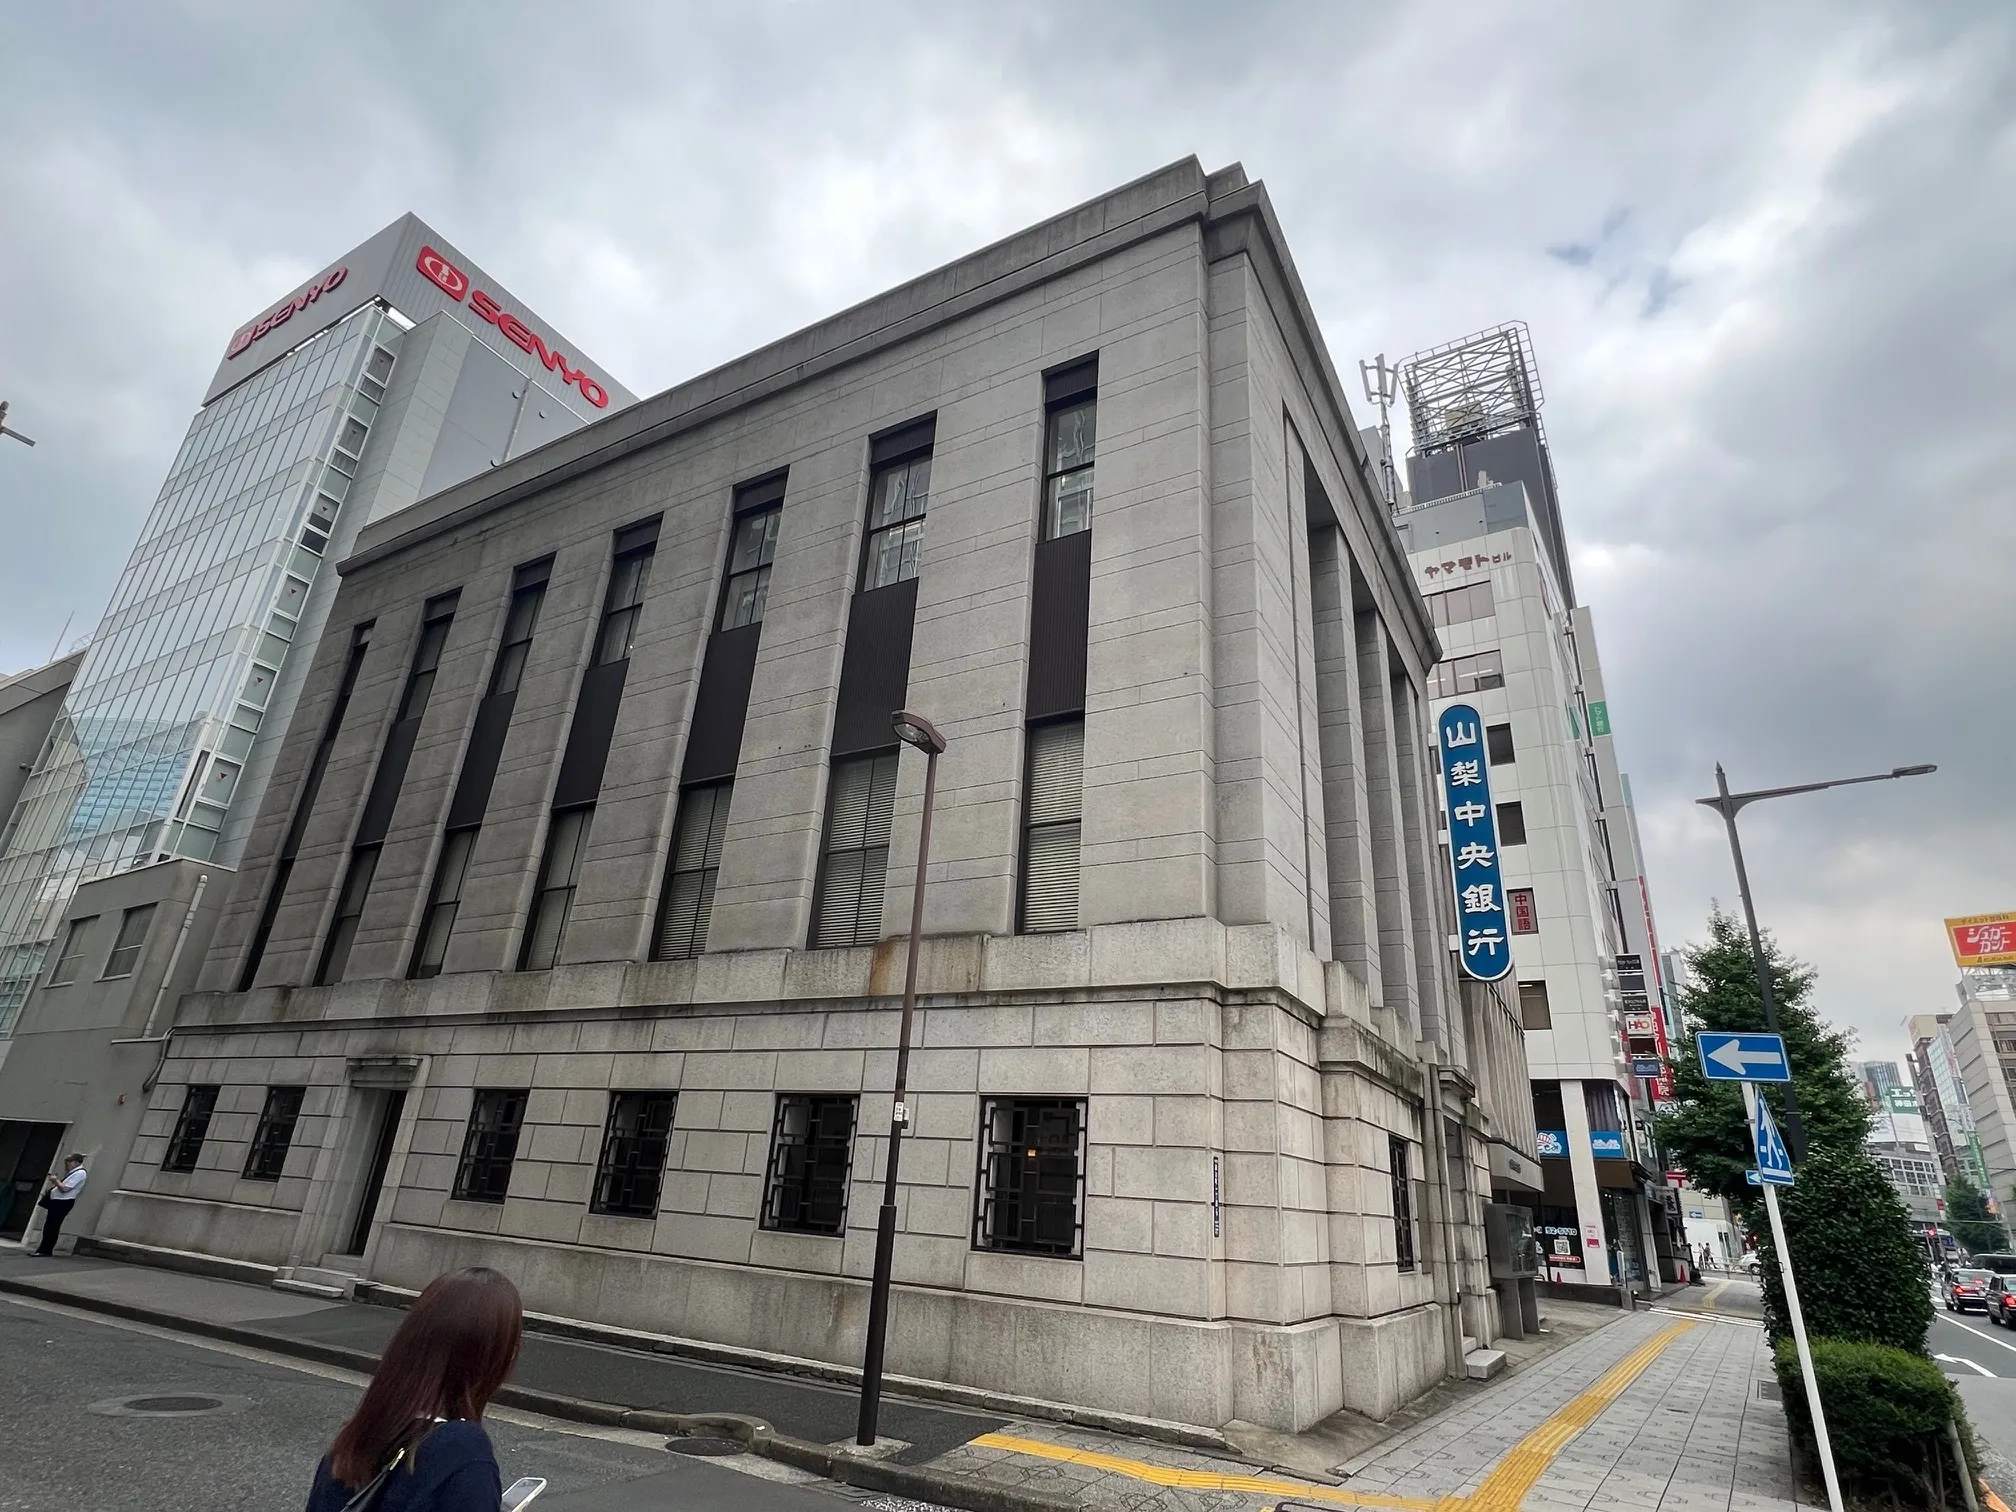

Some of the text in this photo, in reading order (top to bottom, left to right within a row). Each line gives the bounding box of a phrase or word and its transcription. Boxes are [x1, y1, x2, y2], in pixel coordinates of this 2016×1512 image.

[252, 266, 349, 343] SENYO
[468, 289, 609, 409] SENYO
[1424, 551, 1512, 579] ヤマモトビル
[1445, 720, 1505, 957] 山梨中央銀行
[1514, 893, 1532, 932] 中国語
[1966, 925, 2012, 943] シュガー
[1979, 936, 2011, 954] カット
